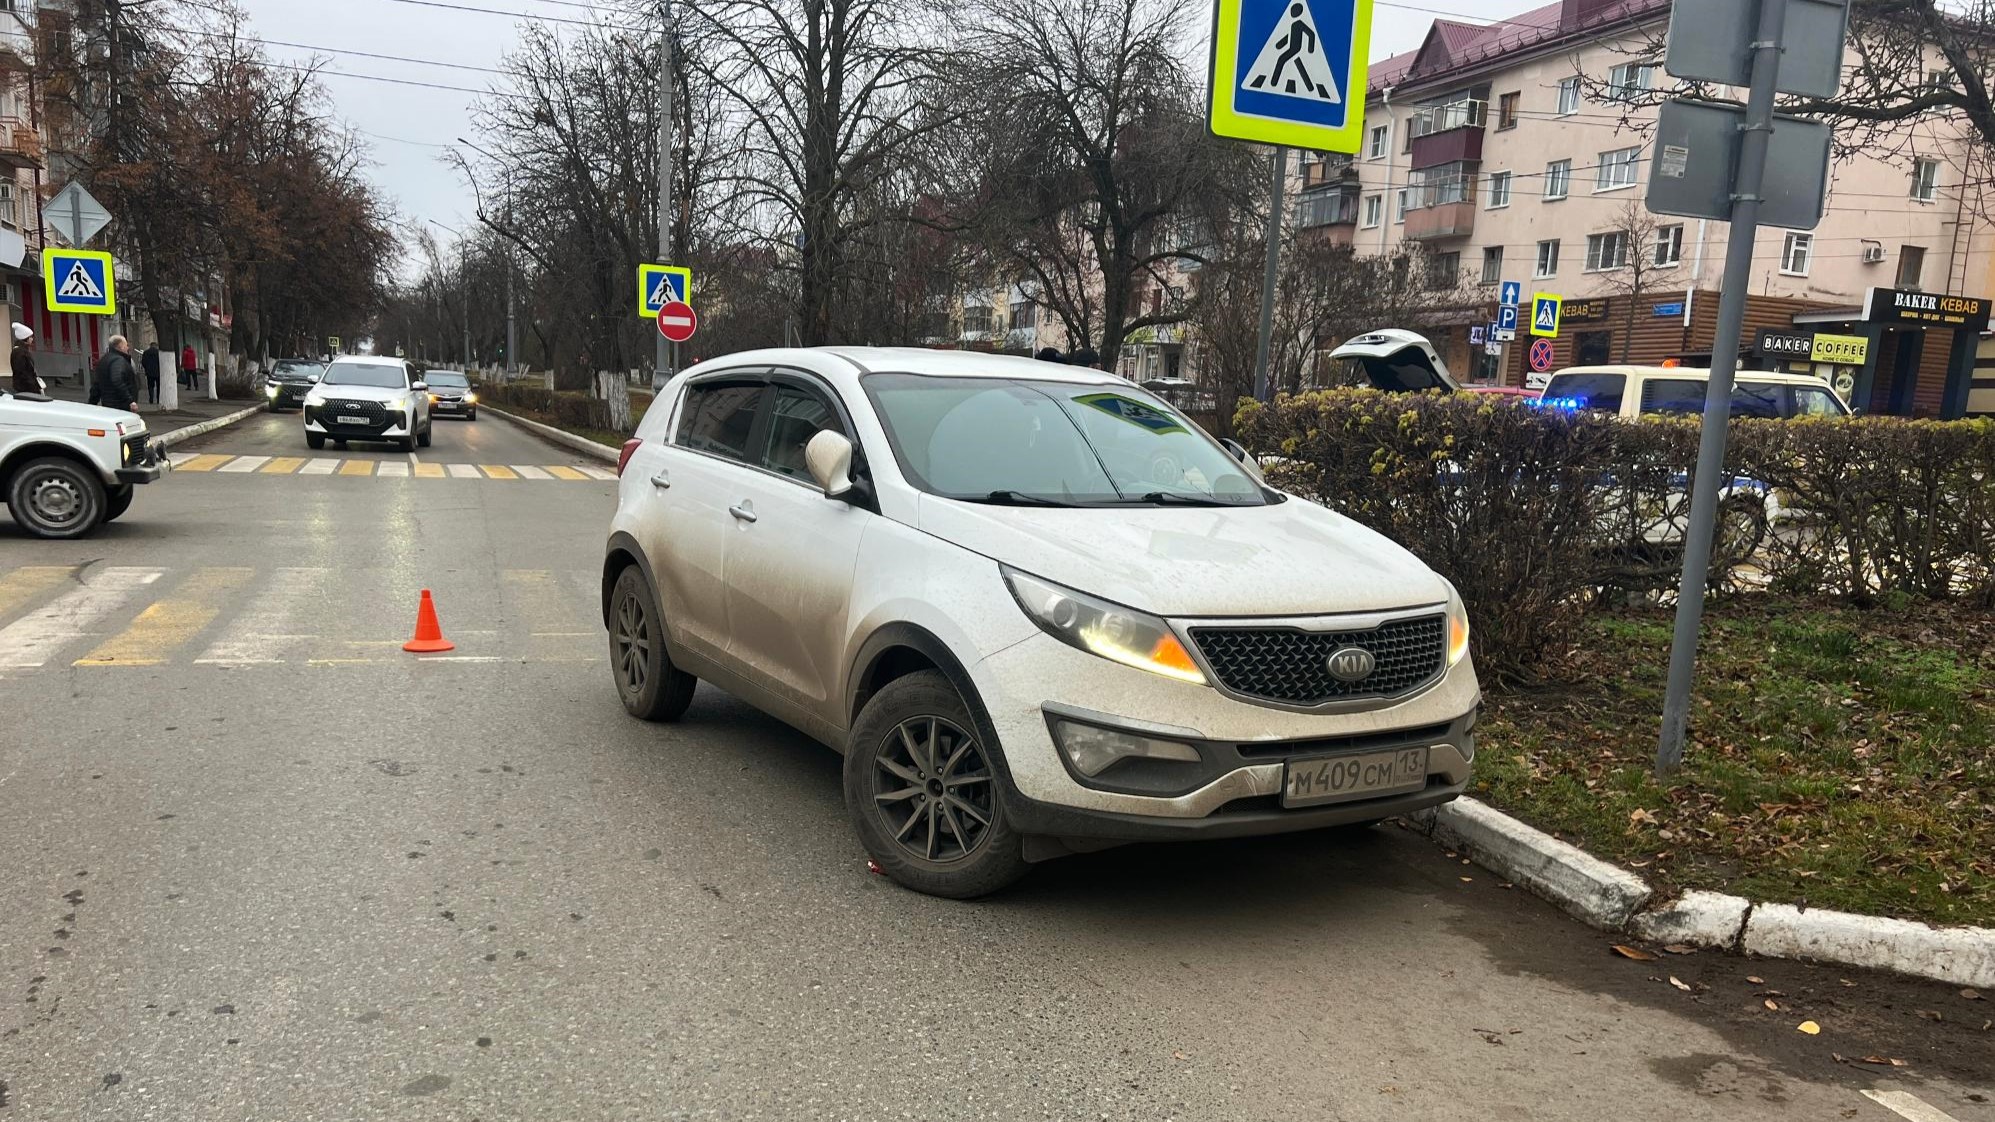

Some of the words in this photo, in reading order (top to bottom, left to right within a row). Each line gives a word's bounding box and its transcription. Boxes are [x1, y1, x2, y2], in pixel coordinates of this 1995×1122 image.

[1560, 305, 1589, 318] KEBAB
[1894, 292, 1937, 310] BAKER
[1940, 297, 1979, 314] KEBAB
[1502, 309, 1515, 327] P
[1764, 337, 1811, 353] BAKER
[1816, 342, 1865, 356] COFFEE
[1337, 654, 1370, 673] KIA
[1295, 760, 1393, 796] М409СМ
[1400, 751, 1420, 773] 13
